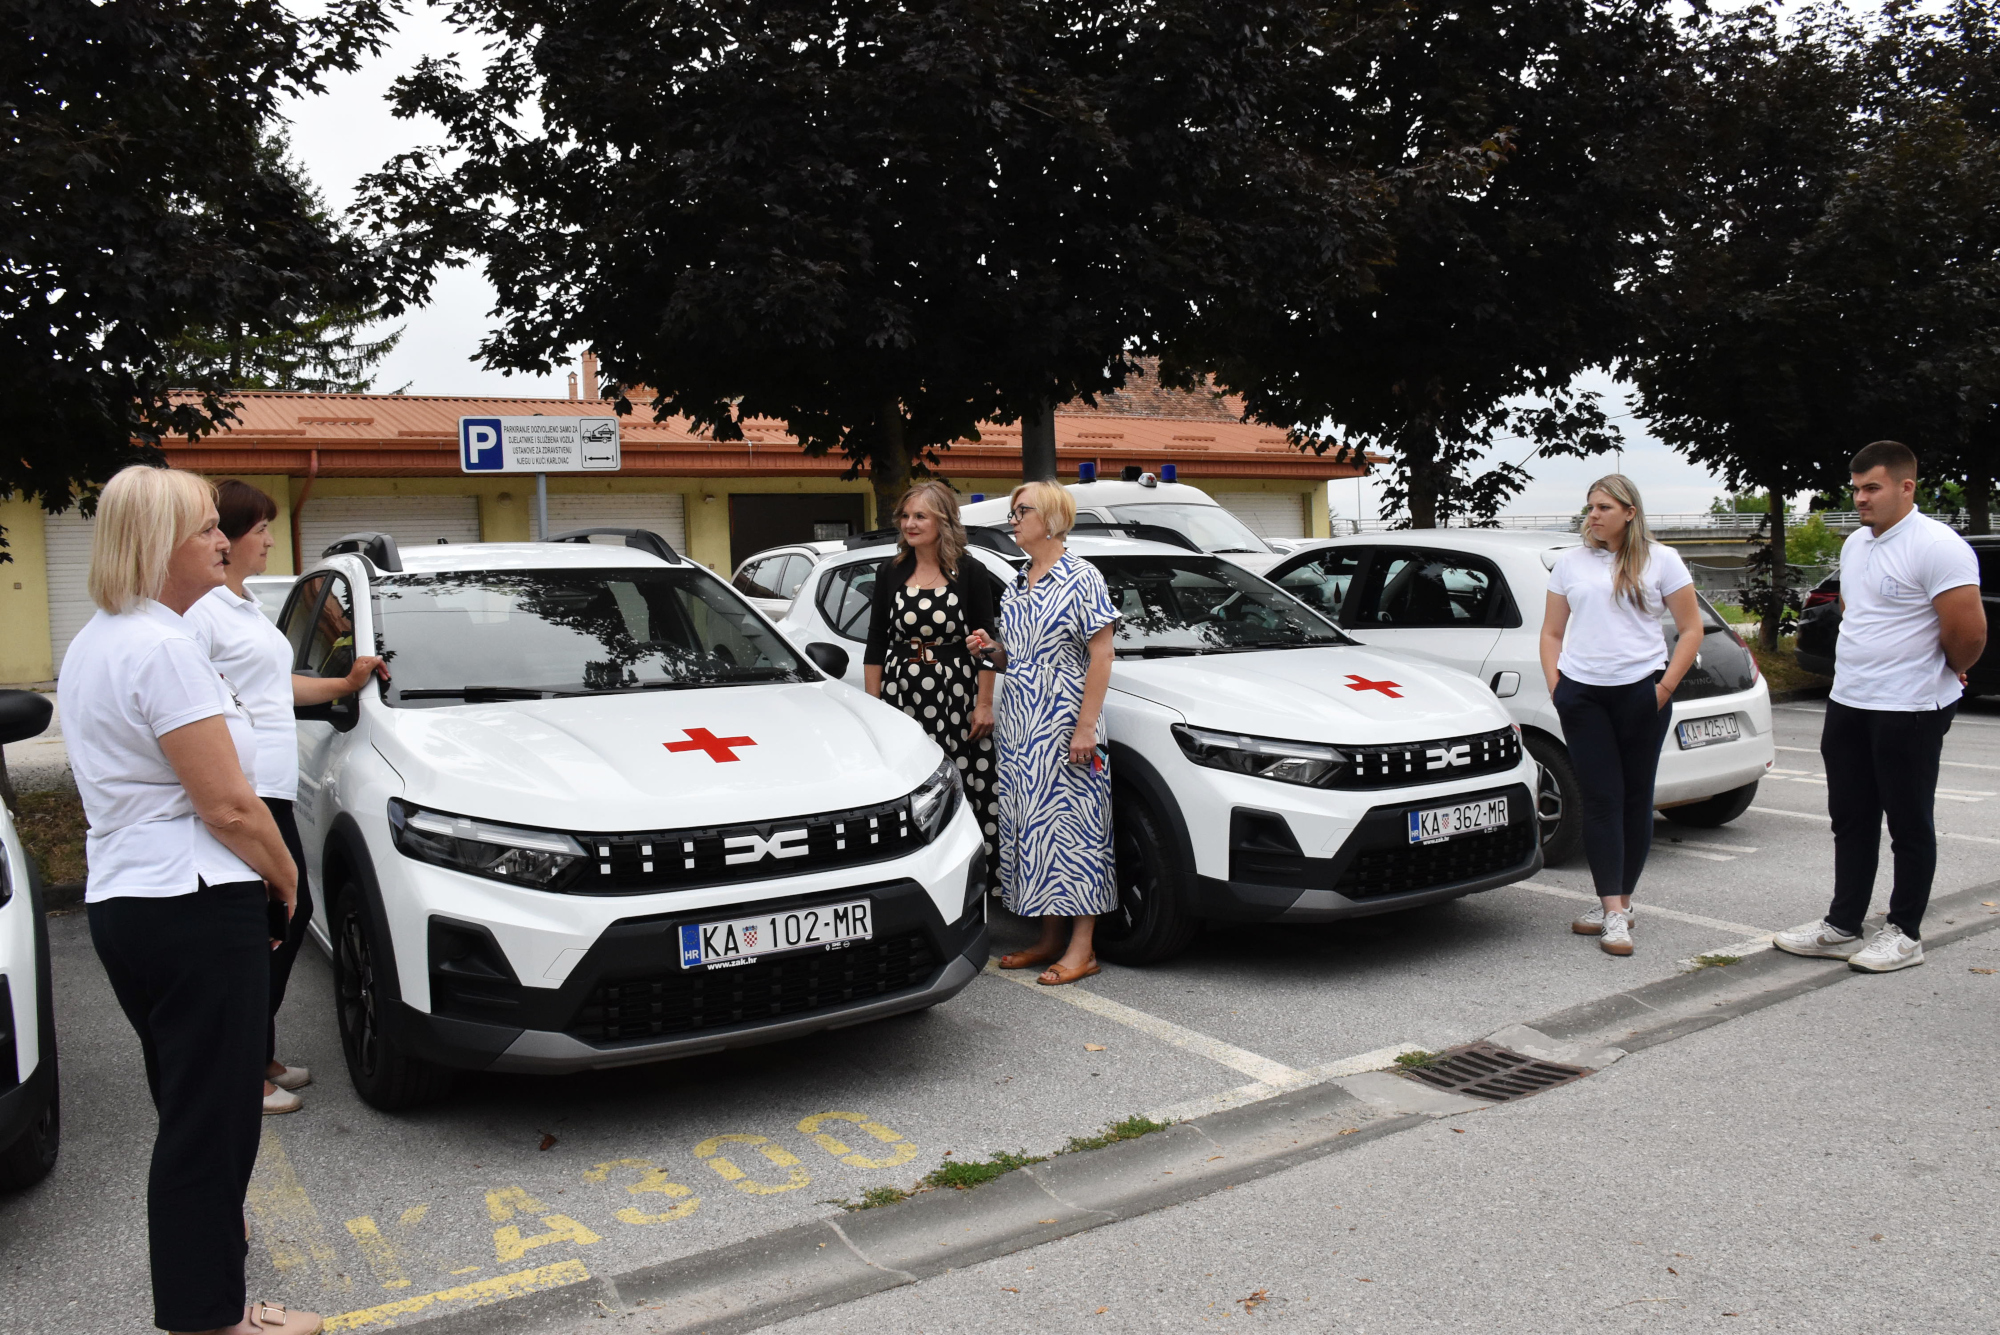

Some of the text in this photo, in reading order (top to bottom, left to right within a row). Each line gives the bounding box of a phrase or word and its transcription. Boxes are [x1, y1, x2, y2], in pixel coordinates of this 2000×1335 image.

[503, 425, 578, 434] PARKIRANJE DOZVOLJENO SAMO ZA
[468, 425, 497, 464] P
[508, 435, 534, 444] DJELATNIKE
[537, 434, 559, 444] SLUŽBENA
[560, 435, 575, 444] VOZILA
[512, 446, 572, 455] USTANOVE ZA ZDRAVSTVENU
[516, 456, 531, 465] NJEGU
[531, 457, 536, 465] U
[546, 456, 570, 465] KARLOVAC
[1684, 723, 1699, 741] KA
[1421, 799, 1506, 837] KA 362-MR
[703, 904, 868, 959] KA 102-MR
[684, 949, 699, 960] HR
[707, 956, 757, 970] www.zak.hr
